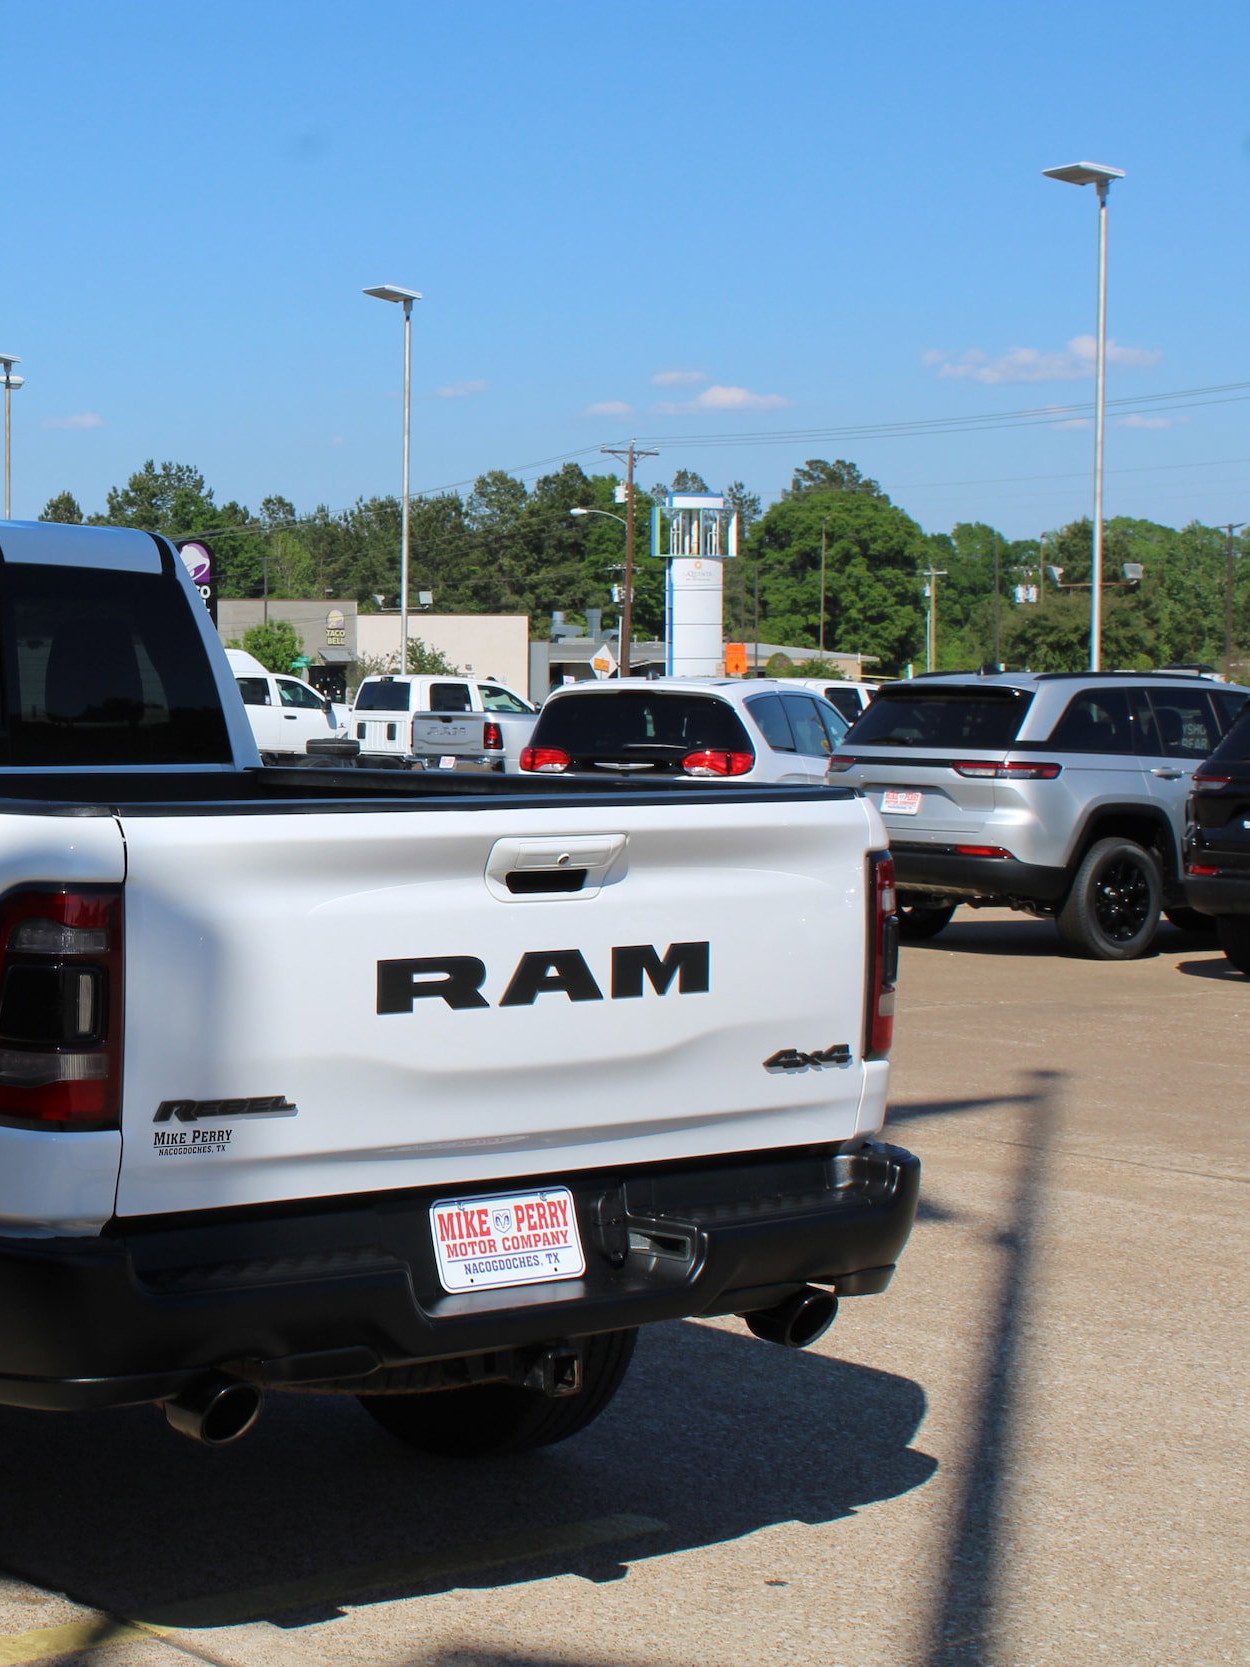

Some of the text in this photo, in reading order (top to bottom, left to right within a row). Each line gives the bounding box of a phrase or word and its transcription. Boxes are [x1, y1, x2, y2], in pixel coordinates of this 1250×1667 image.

[327, 637, 346, 646] BELL
[377, 941, 710, 1015] RAM
[153, 1095, 297, 1123] REBEL
[153, 1129, 233, 1146] MIKE PERRY
[216, 1144, 226, 1153] TX
[437, 1199, 569, 1242] MIKE PERRY
[446, 1230, 569, 1259] MOTOR COMPANY
[464, 1252, 561, 1276] NACOGDOCHES, TX
